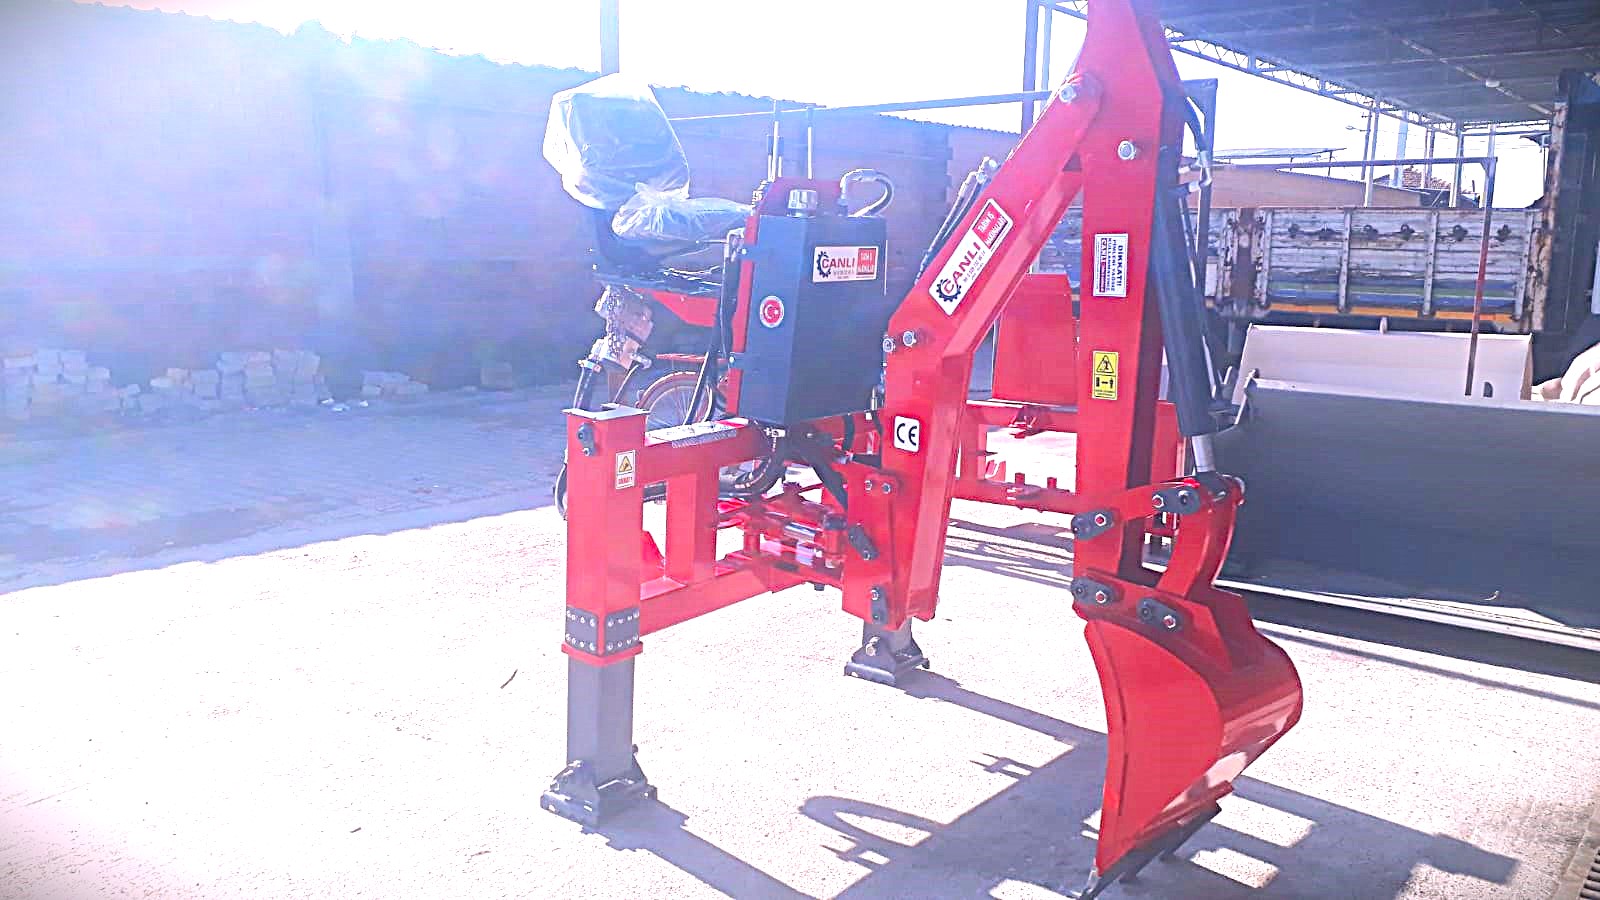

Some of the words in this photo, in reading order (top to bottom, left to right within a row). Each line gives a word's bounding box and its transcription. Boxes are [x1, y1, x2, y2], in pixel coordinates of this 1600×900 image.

[822, 257, 855, 268] CANLI
[944, 241, 981, 294] CANLI
[896, 422, 918, 447] CE
